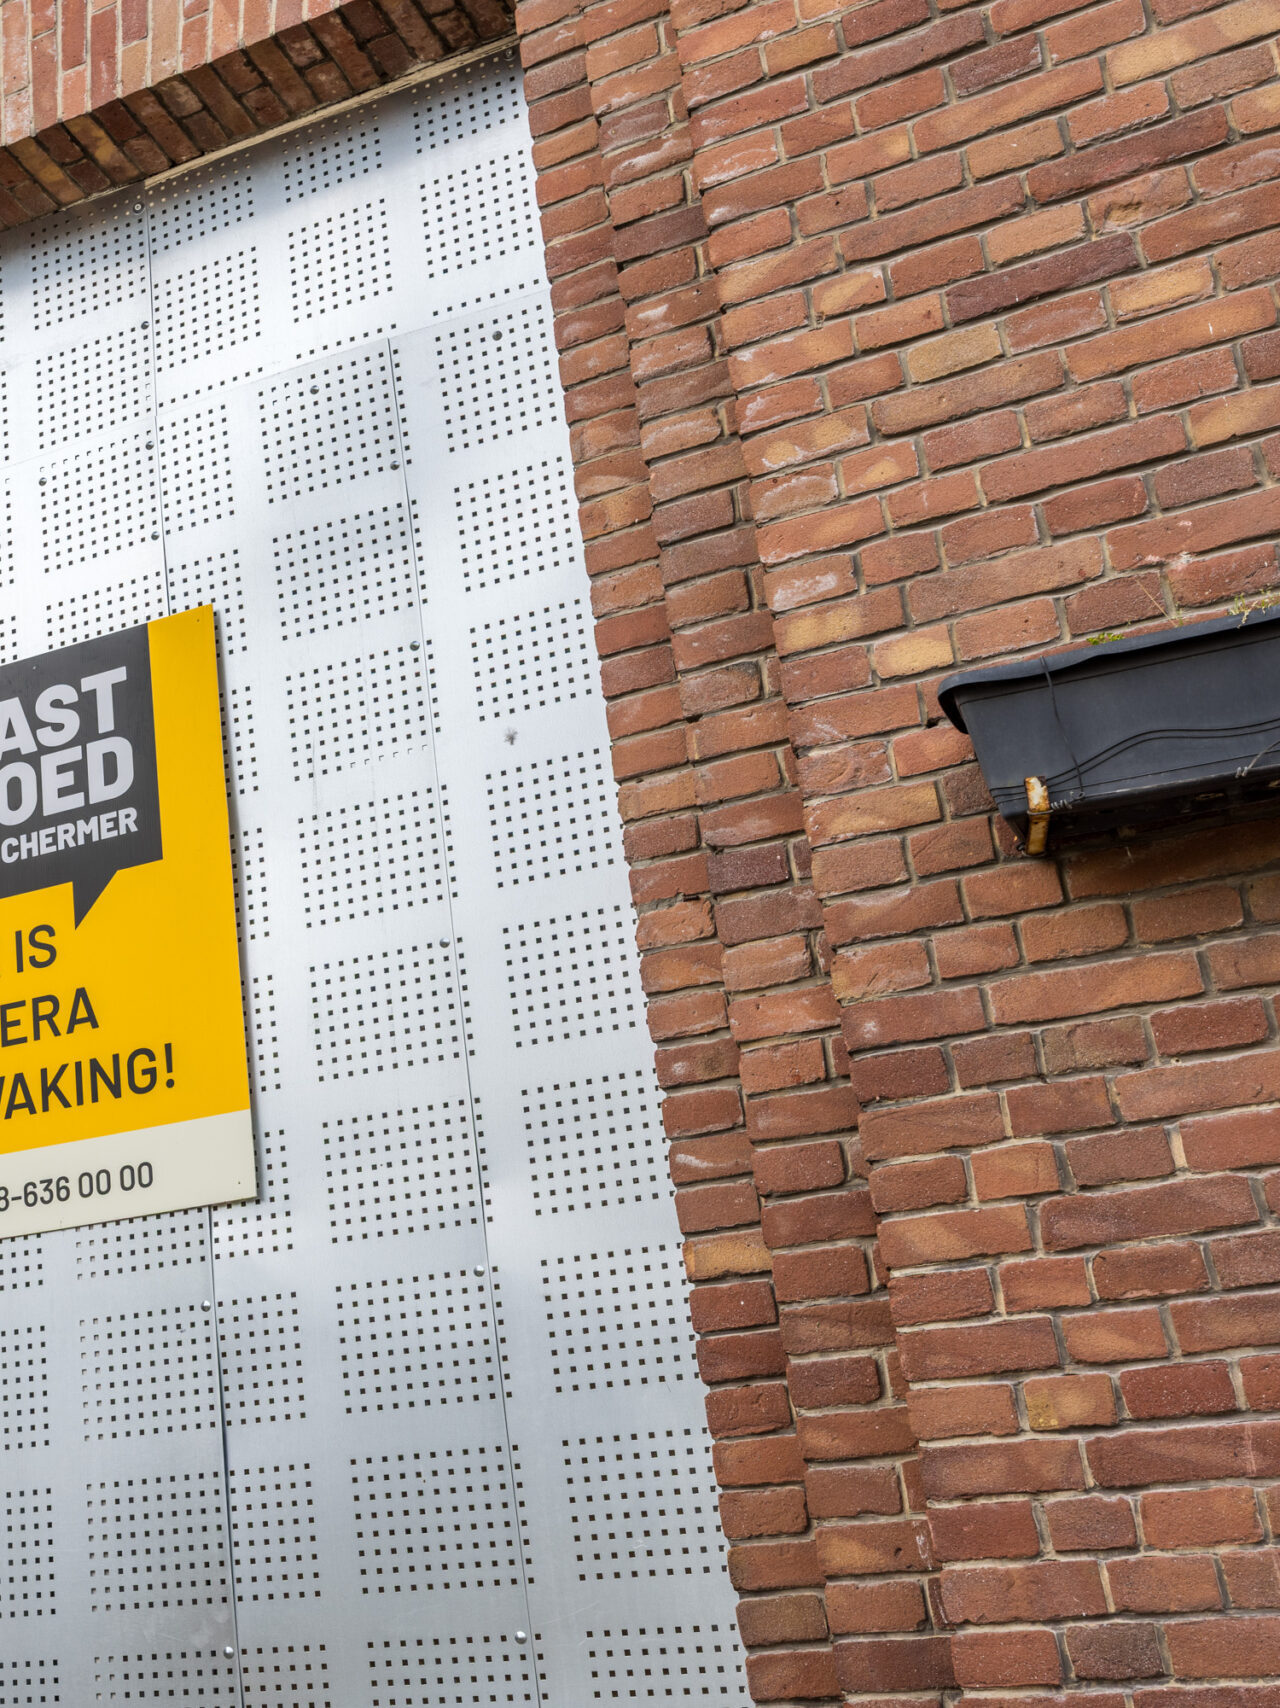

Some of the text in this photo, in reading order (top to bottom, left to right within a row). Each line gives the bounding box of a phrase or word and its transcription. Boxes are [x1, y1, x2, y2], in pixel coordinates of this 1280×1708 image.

[15, 924, 57, 973] IS
[78, 1168, 111, 1199] 00
[119, 1161, 154, 1192] 00
